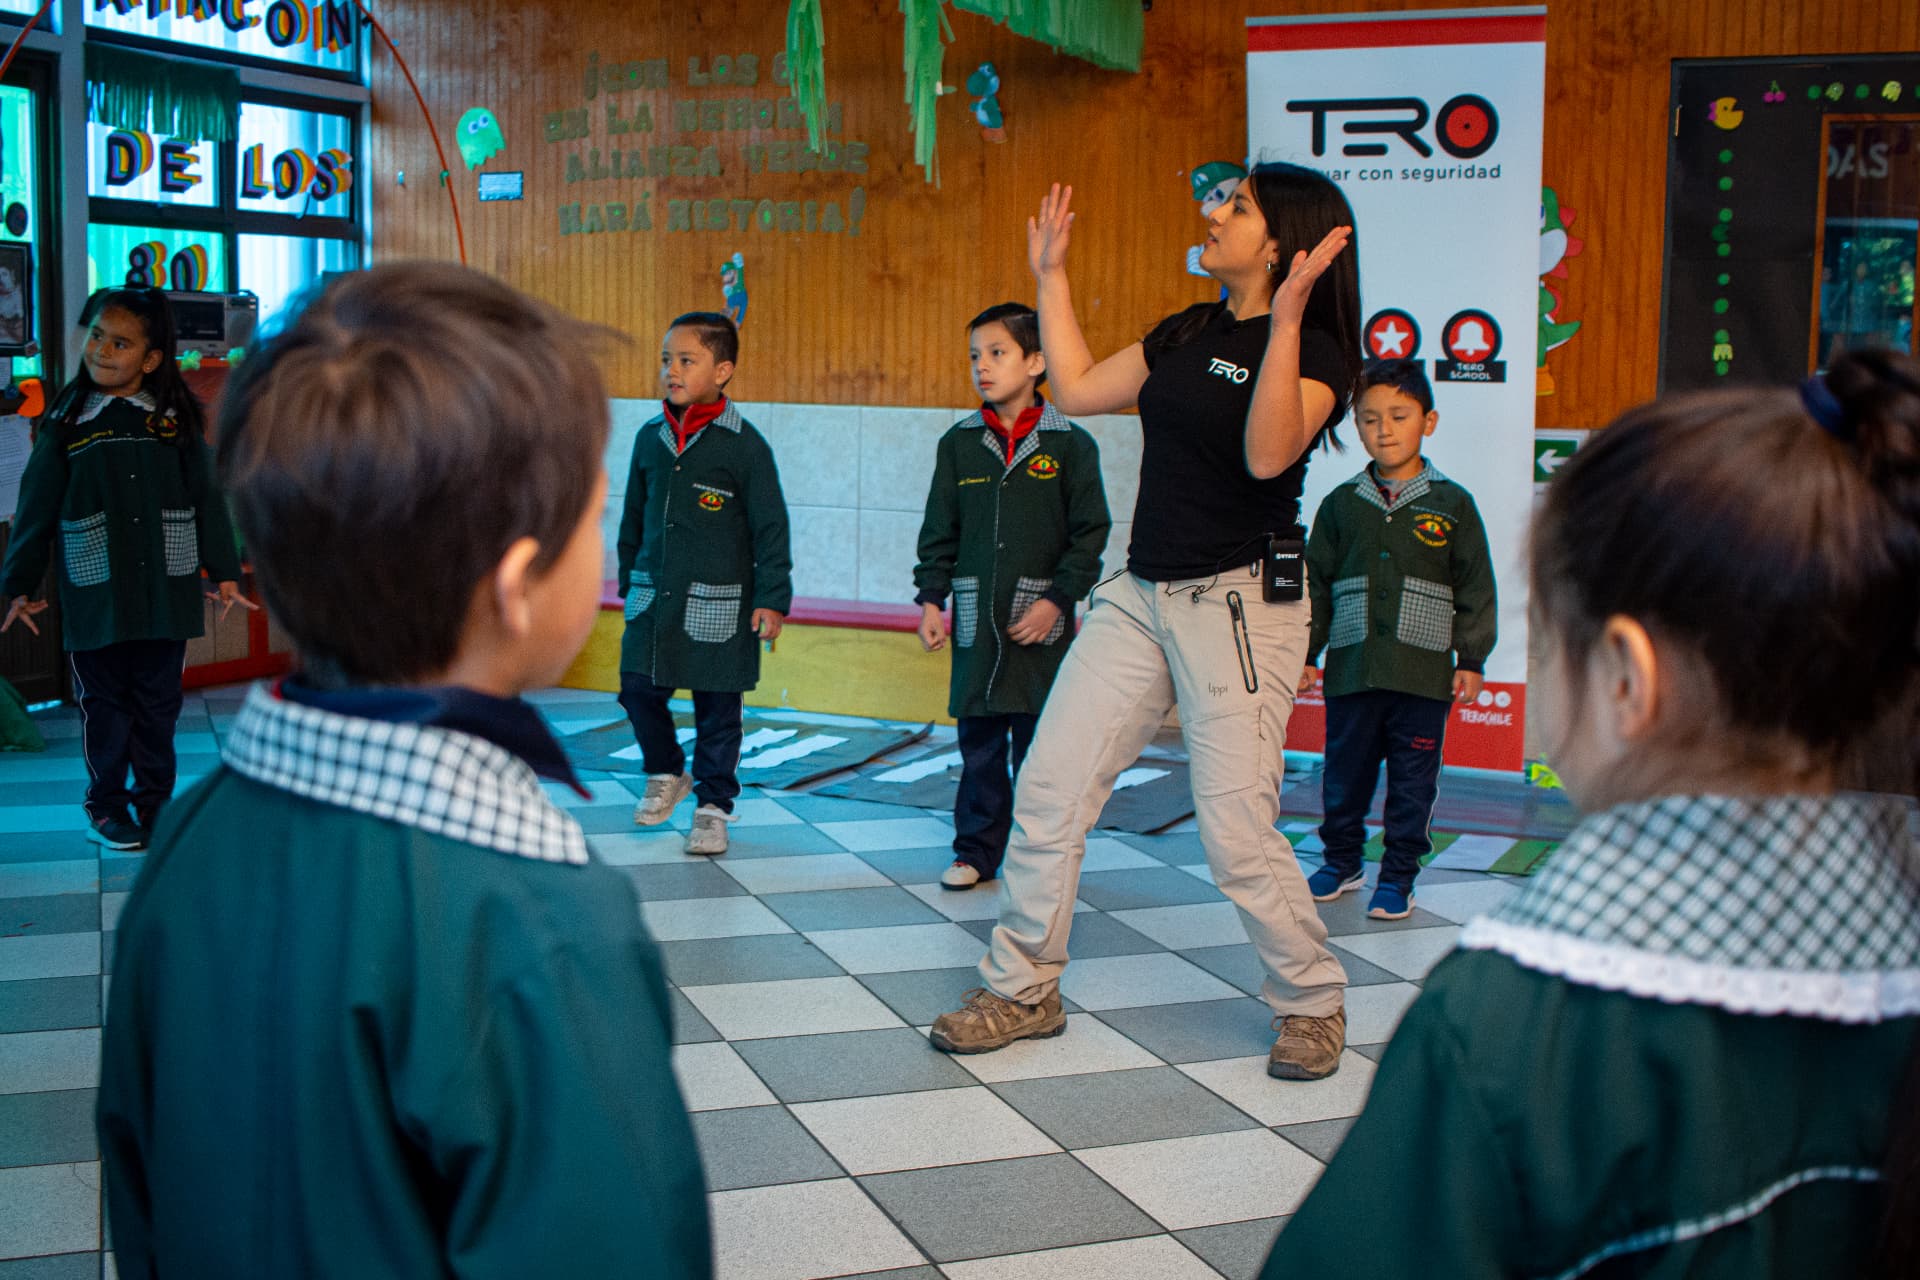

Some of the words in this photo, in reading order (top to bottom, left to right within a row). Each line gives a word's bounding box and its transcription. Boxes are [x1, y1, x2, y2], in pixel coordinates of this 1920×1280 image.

[687, 54, 759, 87] LOS
[543, 107, 590, 143] EN
[606, 101, 653, 134] LA
[1286, 93, 1500, 159] TERO
[106, 130, 202, 194] DE
[240, 142, 353, 201] LOS
[565, 145, 723, 184] ALIANZA
[1358, 167, 1393, 181] con
[1401, 164, 1501, 182] seguridad
[557, 191, 653, 235] HARÁ
[667, 186, 866, 238] HISTORIA!
[125, 240, 209, 291] 80
[1208, 356, 1250, 385] TERO
[1450, 370, 1491, 380] SCHOOL
[1457, 362, 1485, 371] TERO
